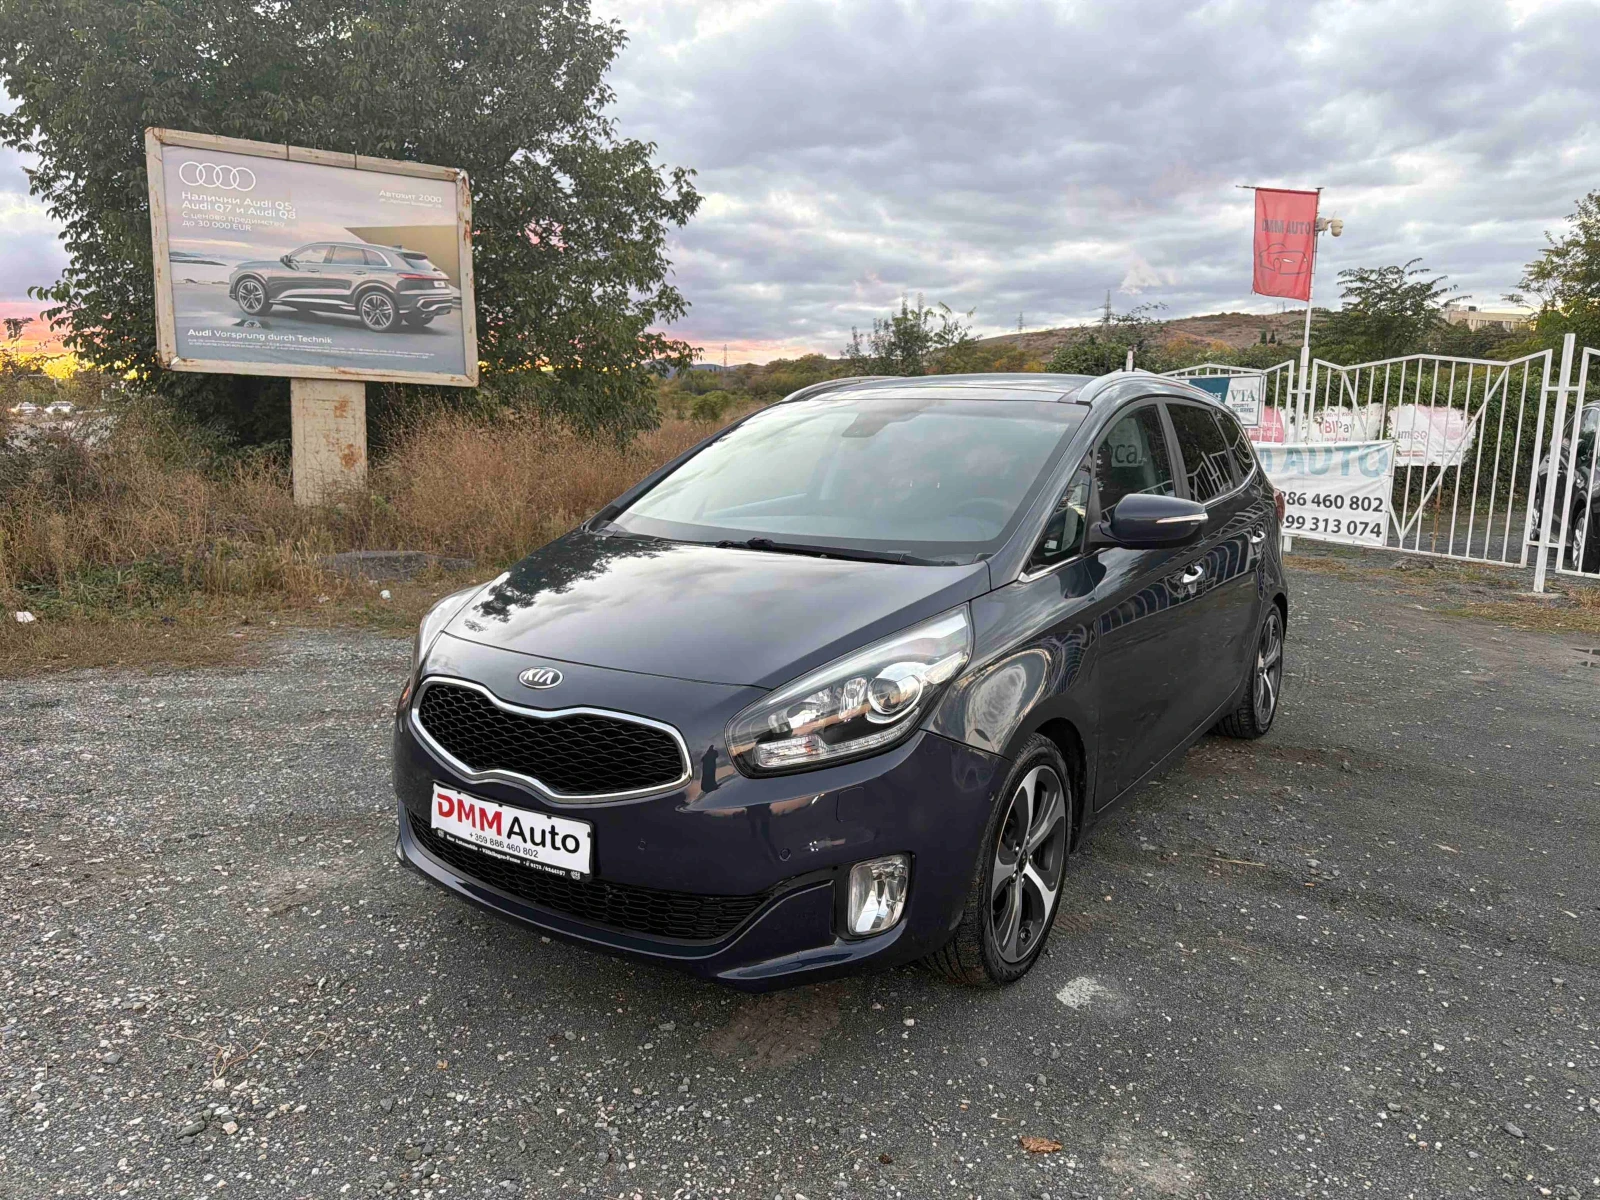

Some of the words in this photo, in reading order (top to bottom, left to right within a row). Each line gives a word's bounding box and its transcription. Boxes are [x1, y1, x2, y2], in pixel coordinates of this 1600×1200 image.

[181, 191, 240, 205] Налични
[243, 198, 272, 208] Audi
[418, 193, 442, 203] 2000
[181, 200, 211, 211] Audi
[214, 203, 233, 214] Q7
[247, 207, 276, 217] Audi
[278, 209, 296, 220] Q8
[181, 210, 189, 218] С
[190, 213, 226, 222] ценово
[197, 219, 210, 228] 30
[211, 221, 231, 230] 000
[232, 223, 252, 232] EUR
[1286, 220, 1311, 235] AUTO
[187, 328, 212, 337] Audi
[214, 329, 266, 341] Vorsprung
[267, 333, 295, 342] durch
[297, 334, 333, 344] Technik
[1230, 389, 1256, 402] VTA
[1281, 445, 1389, 478] AUTO
[1311, 493, 1345, 509] 460
[1349, 495, 1384, 513] 802
[1281, 514, 1306, 530] 99
[1309, 516, 1342, 534] 313
[1346, 520, 1382, 538] 074
[522, 668, 555, 685] KIA
[436, 792, 503, 837] DMM
[506, 815, 581, 854] Auto
[489, 837, 505, 849] 886
[506, 842, 521, 854] 460
[522, 846, 539, 859] 802
